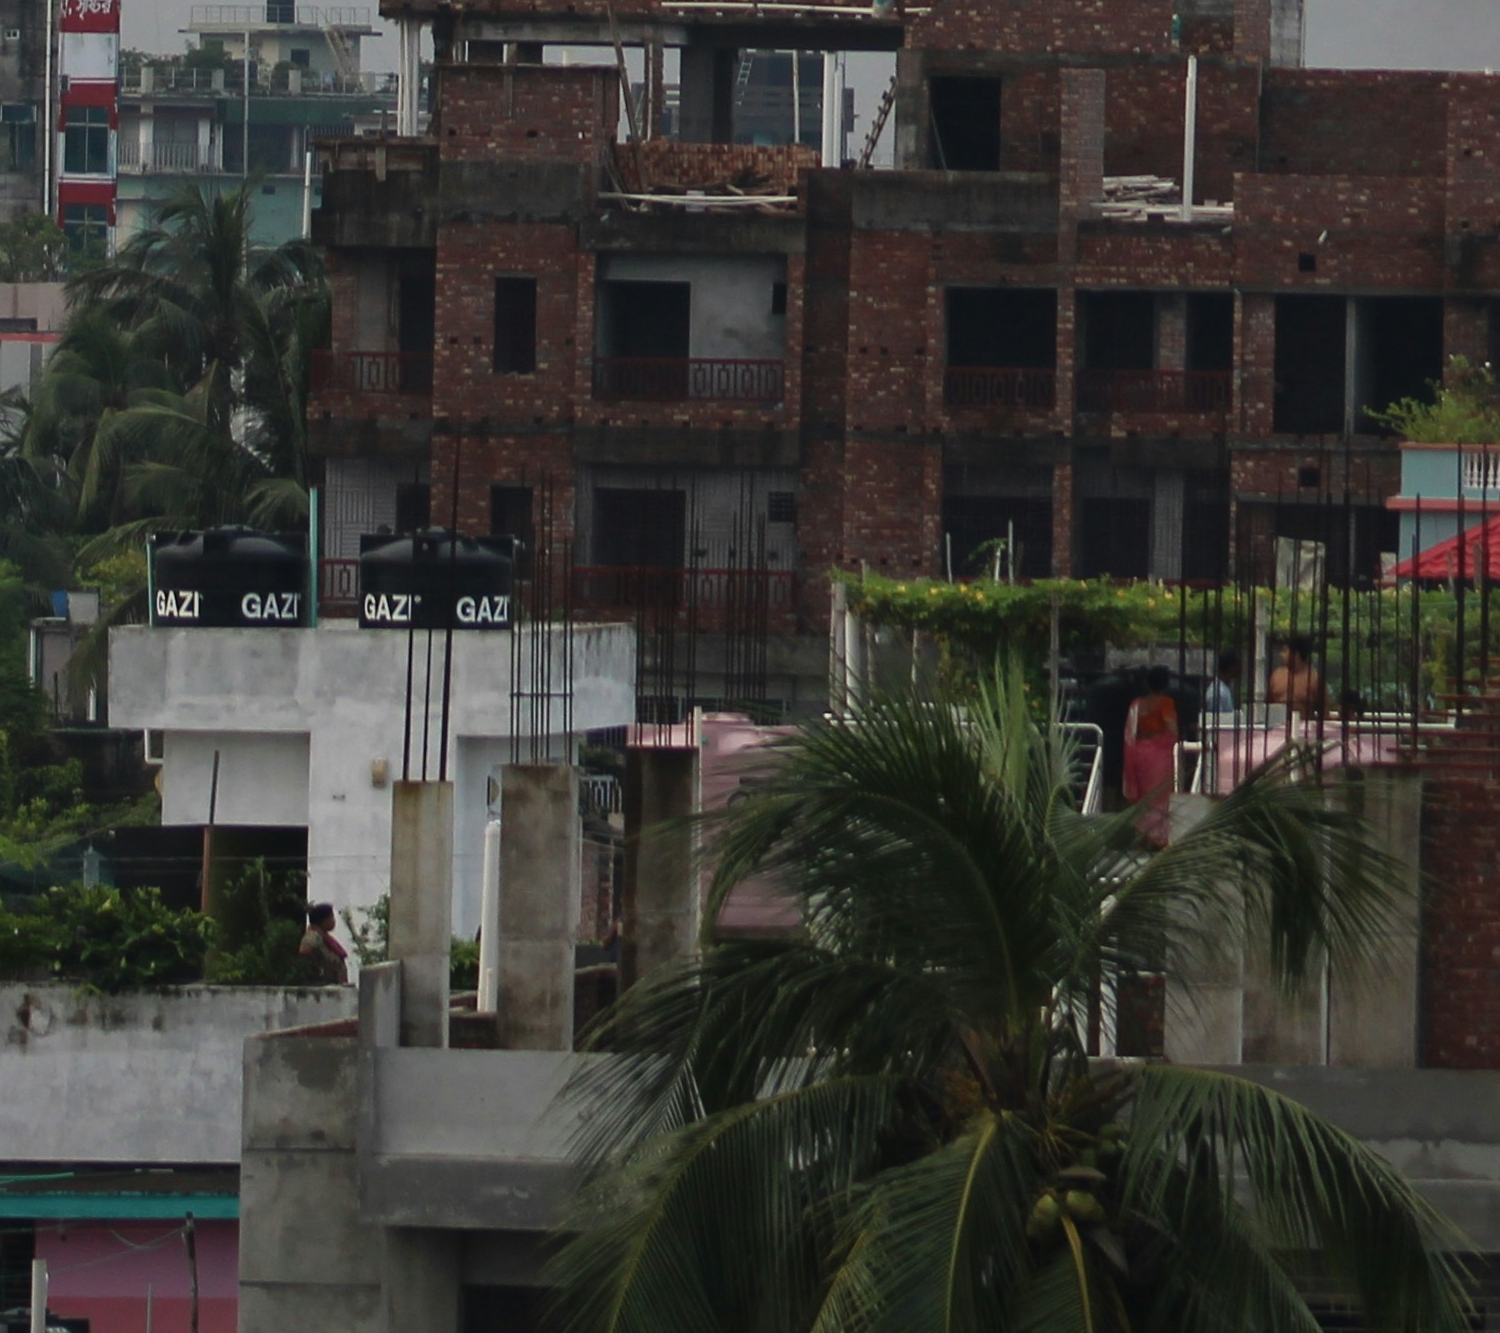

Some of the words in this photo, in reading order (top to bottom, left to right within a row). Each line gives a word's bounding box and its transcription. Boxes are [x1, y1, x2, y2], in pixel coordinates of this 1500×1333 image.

[156, 590, 199, 617] GAZI
[241, 593, 298, 619] GAZI
[364, 593, 412, 621] GAZI
[456, 596, 508, 622] GAZI
